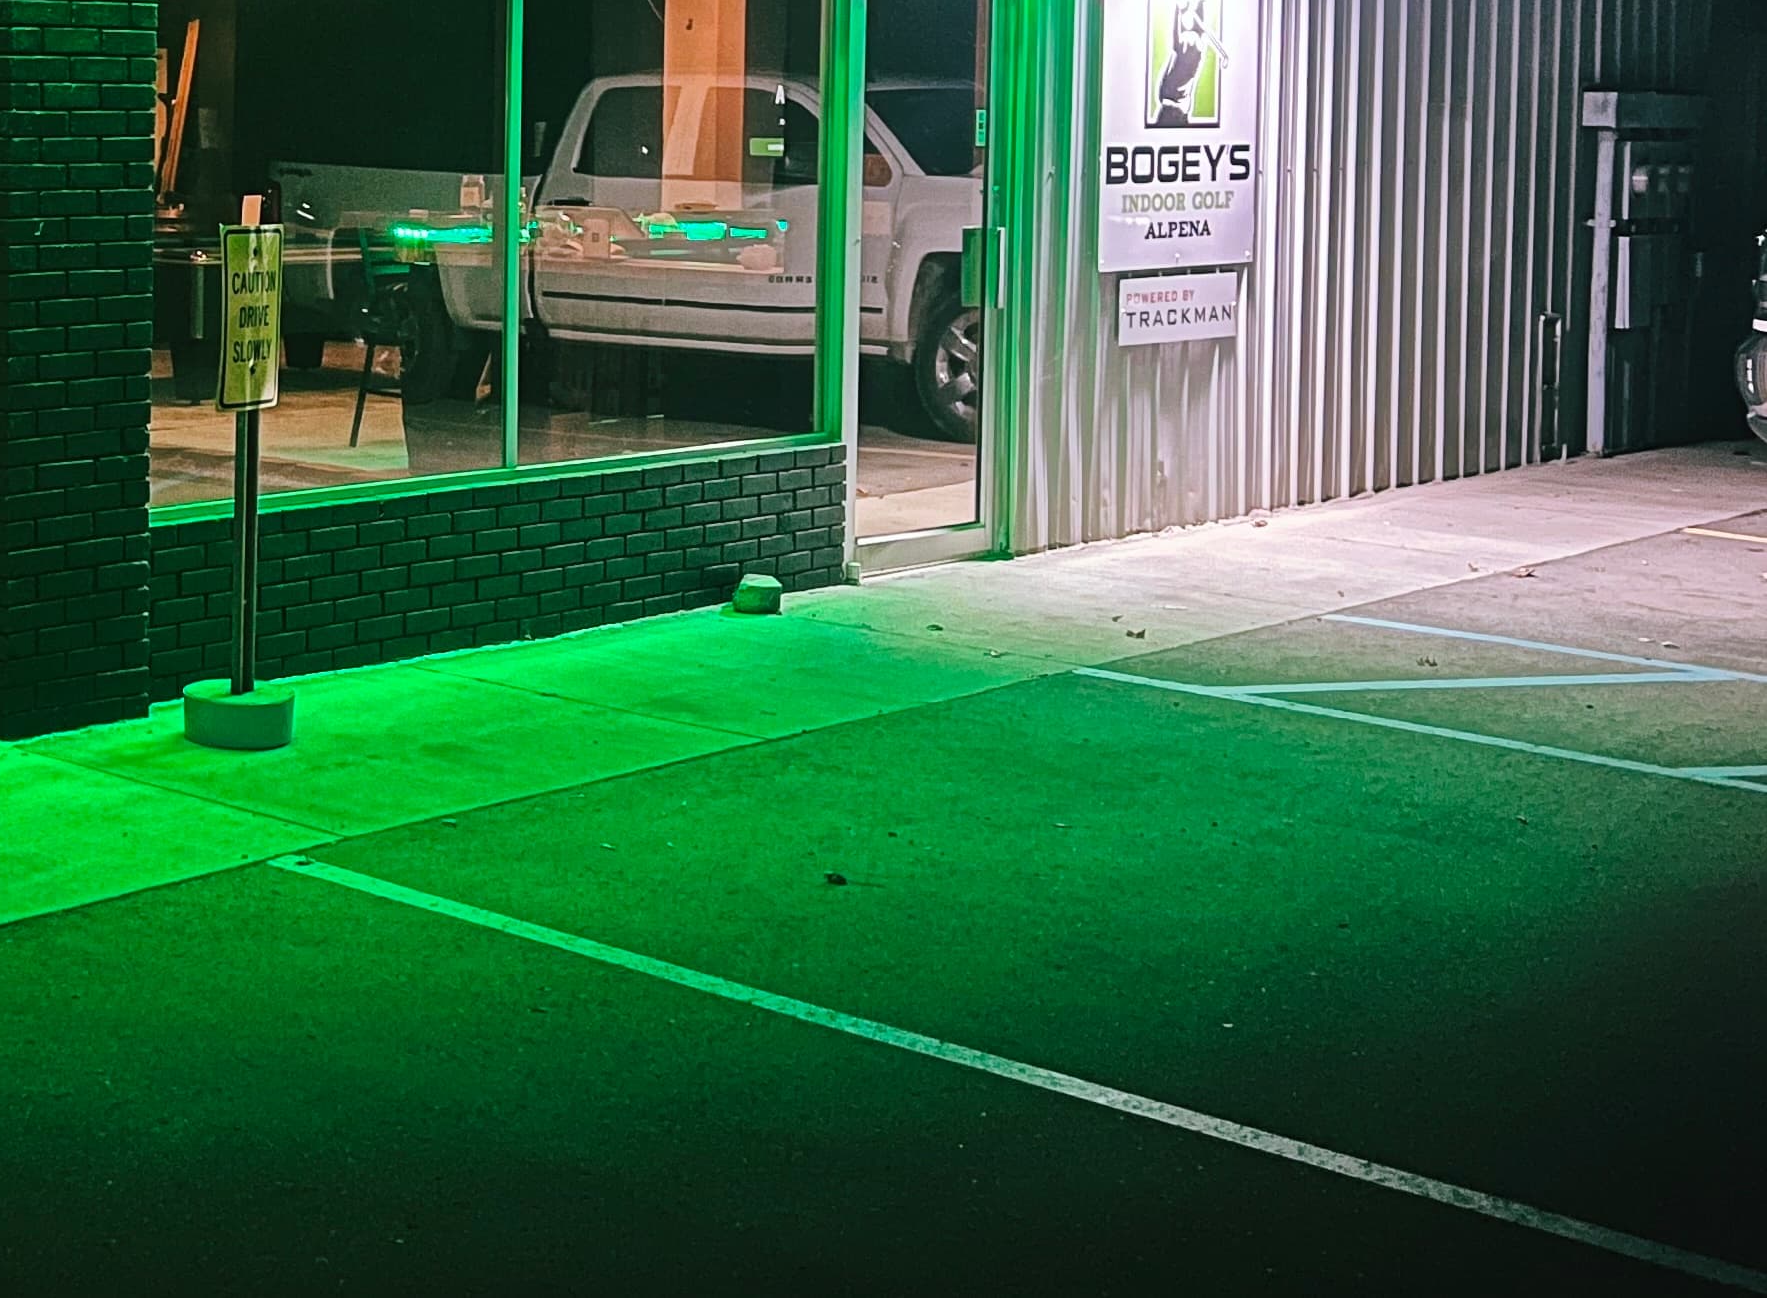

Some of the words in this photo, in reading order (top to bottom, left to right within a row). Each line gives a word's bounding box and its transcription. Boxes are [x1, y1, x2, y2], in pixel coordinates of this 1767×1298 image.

[1106, 144, 1250, 184] BOGEY'S
[1121, 192, 1185, 213] INDOOR
[1192, 190, 1234, 210] GOLF
[1144, 219, 1211, 240] ALPENA
[232, 271, 276, 295] CAUTION
[1126, 290, 1178, 304] POWERED
[1182, 289, 1194, 302] BY
[239, 304, 270, 328] DRIVE
[1126, 305, 1232, 329] TRACKMAN
[233, 339, 272, 364] SLOWLY
